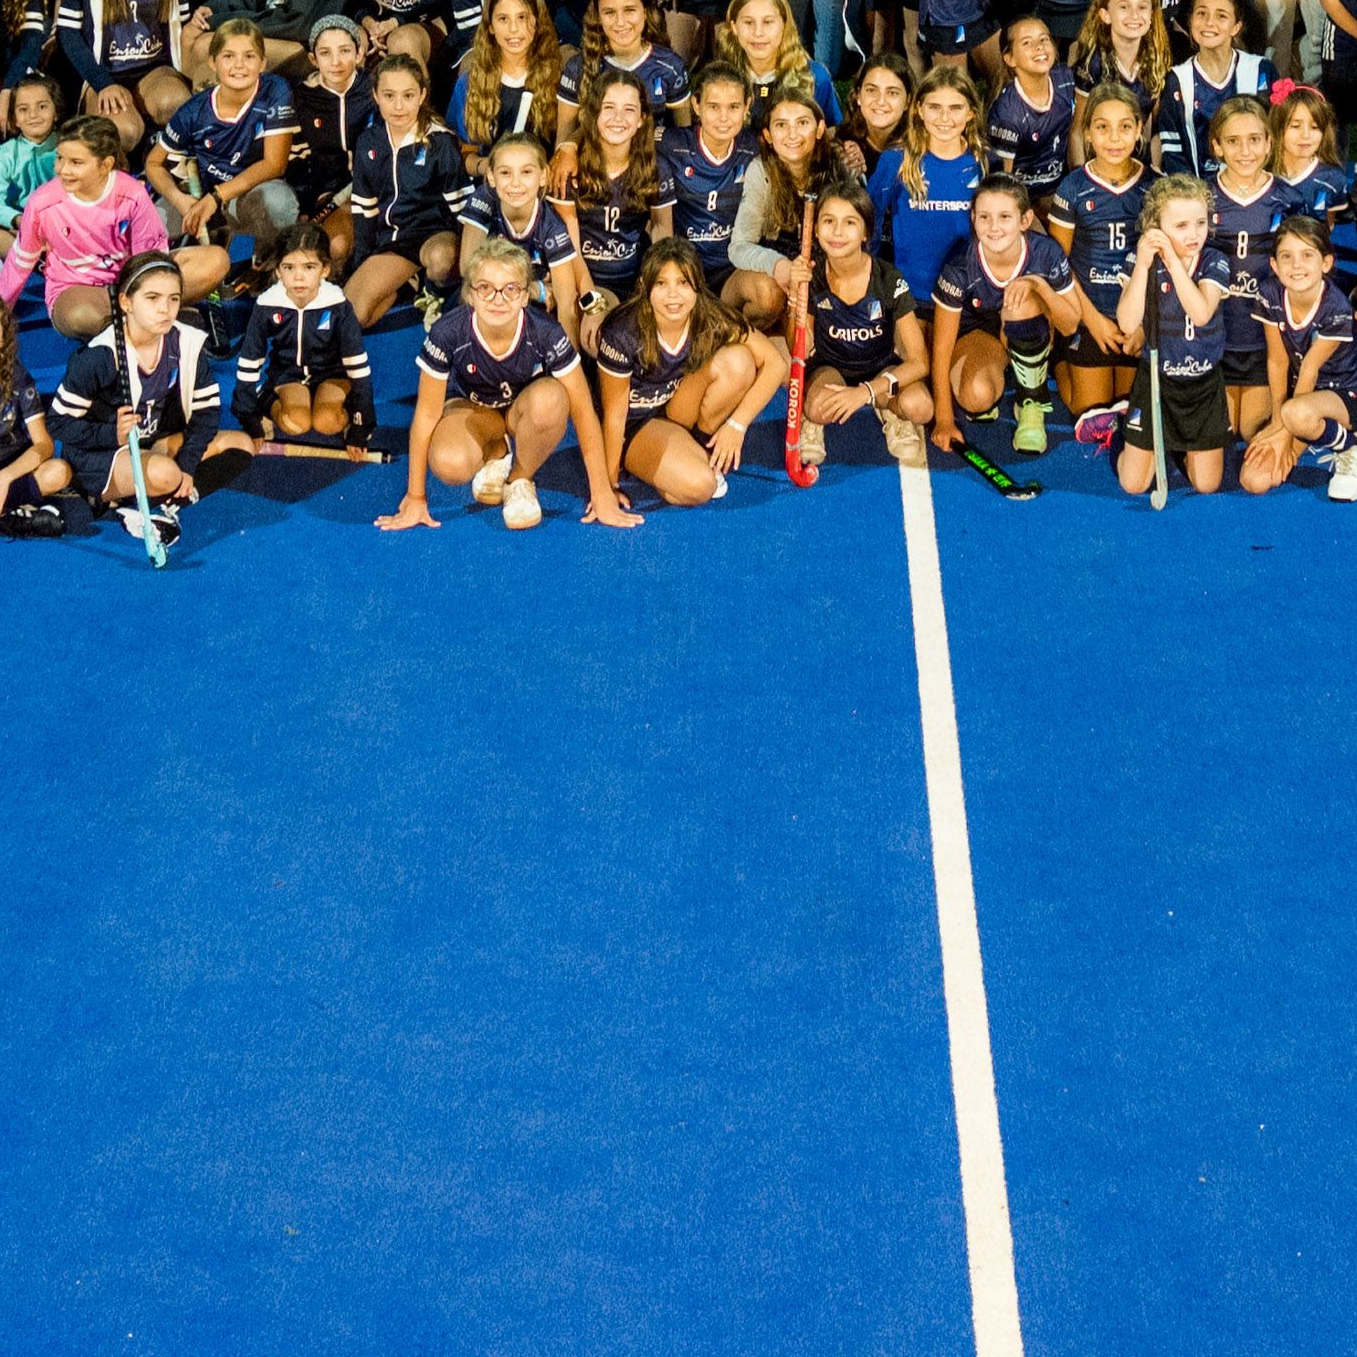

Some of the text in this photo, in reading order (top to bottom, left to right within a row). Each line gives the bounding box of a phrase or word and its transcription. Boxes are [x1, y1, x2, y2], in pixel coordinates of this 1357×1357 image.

[110, 40, 144, 60] Enjoy
[707, 190, 718, 212] 8
[918, 200, 972, 212] INTERSPO
[604, 206, 620, 232] 12
[1108, 223, 1126, 250] 15
[1237, 230, 1248, 258] 8
[1164, 359, 1212, 374] Enjoy Cuba
[500, 382, 512, 398] 3
